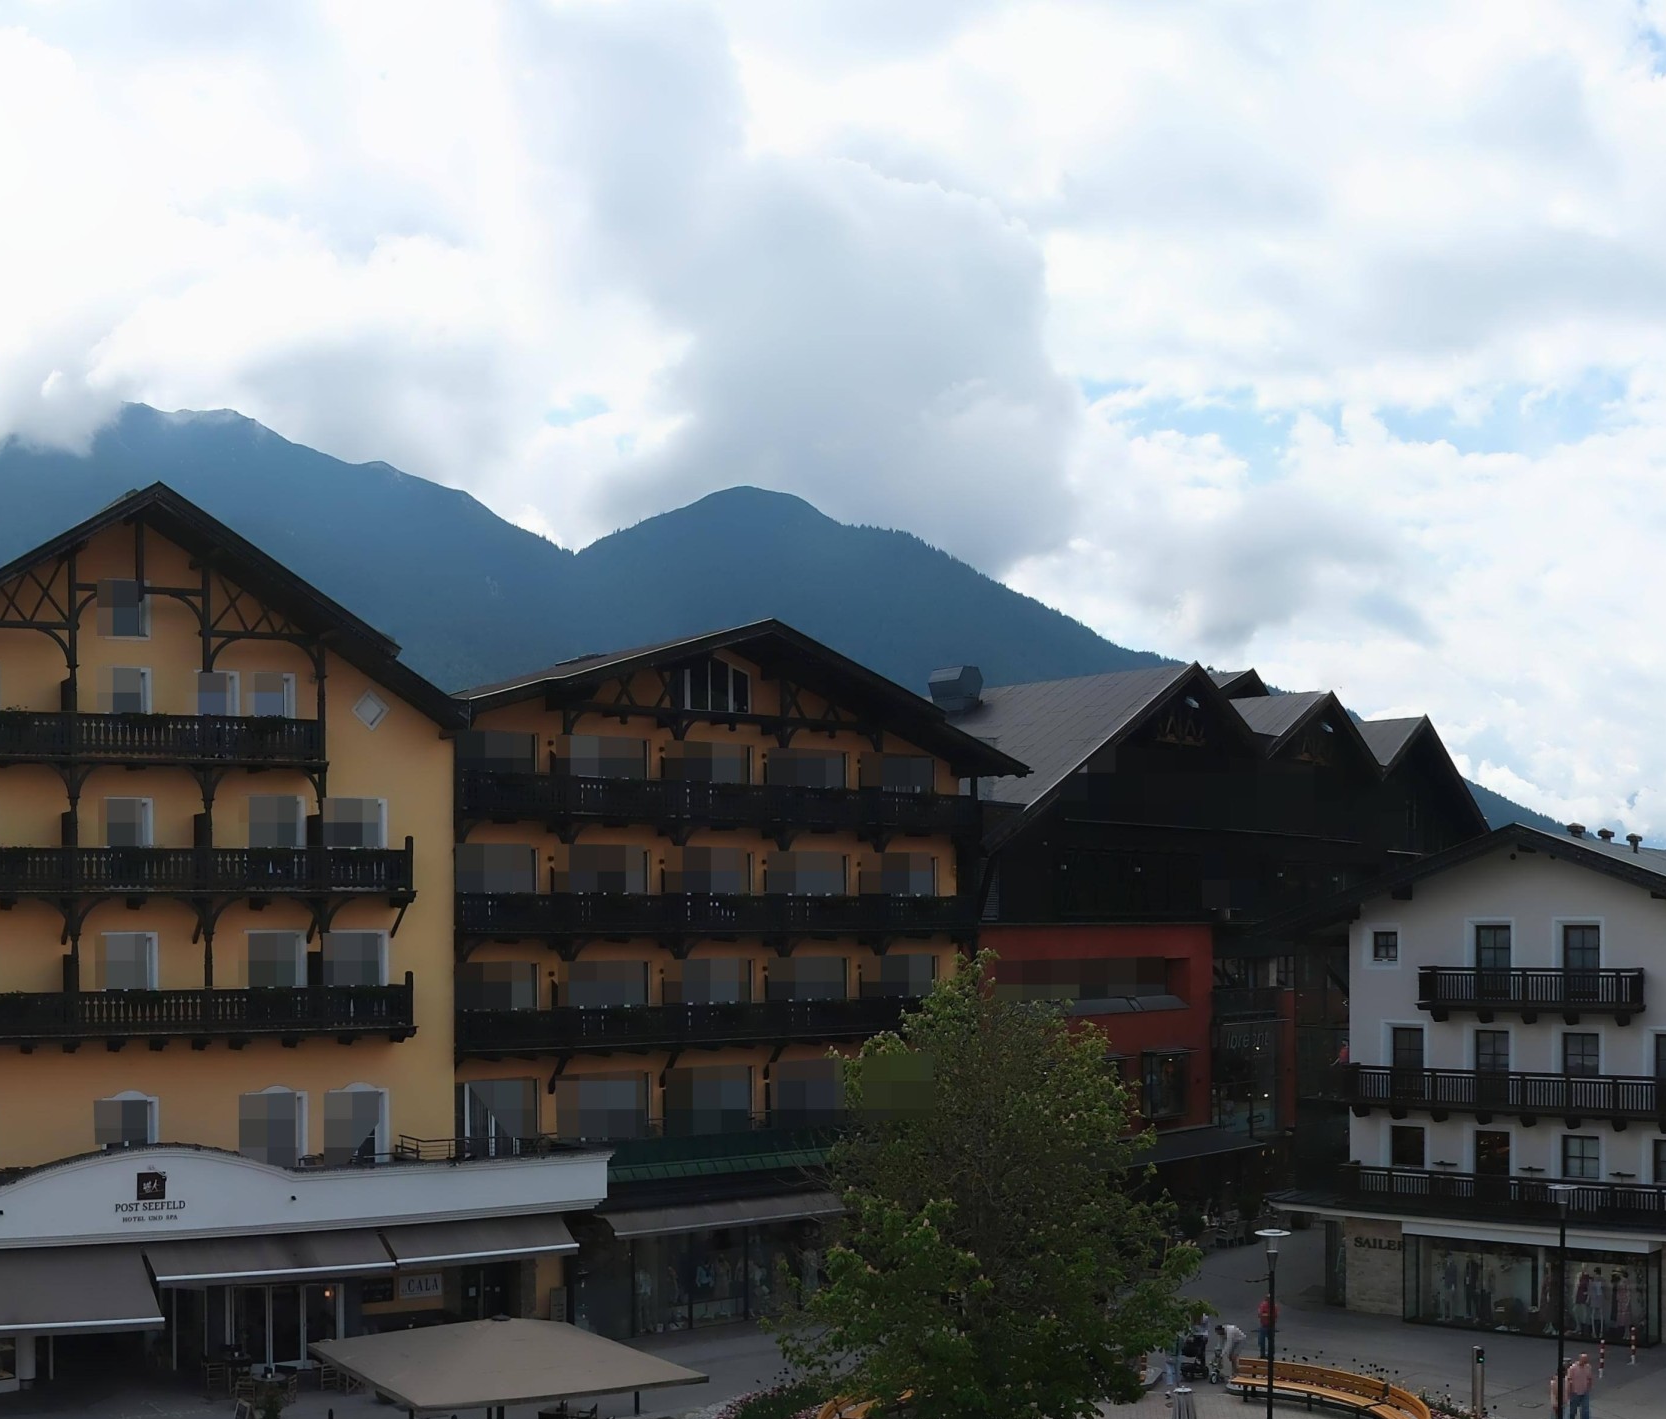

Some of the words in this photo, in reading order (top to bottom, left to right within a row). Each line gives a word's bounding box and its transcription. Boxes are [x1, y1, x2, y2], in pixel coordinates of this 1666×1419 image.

[115, 1203, 140, 1213] POST
[142, 1200, 186, 1211] SEEFELD
[408, 1277, 438, 1292] CALA
